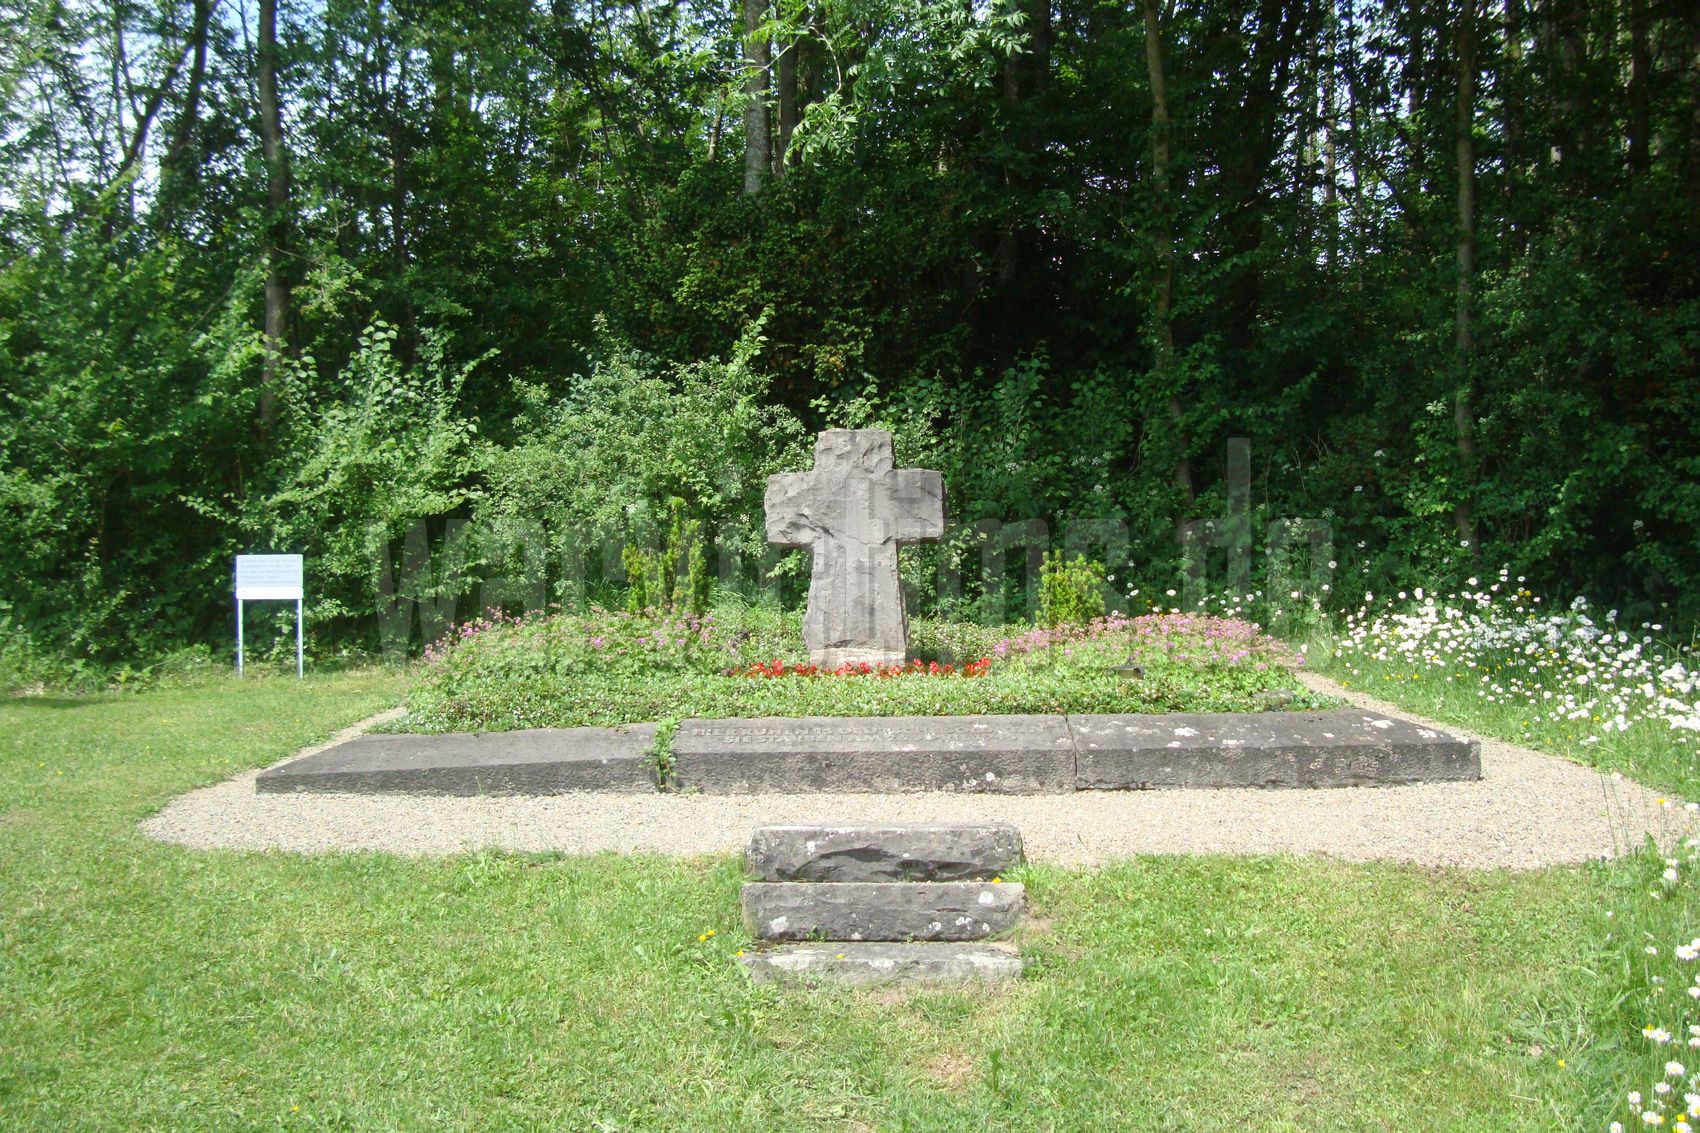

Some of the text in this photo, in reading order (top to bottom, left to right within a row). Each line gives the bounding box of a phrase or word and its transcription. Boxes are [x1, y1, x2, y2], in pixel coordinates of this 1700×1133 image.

[690, 726, 736, 737] HIER
[740, 726, 809, 736] RUHEN
[723, 735, 751, 744] SIE
